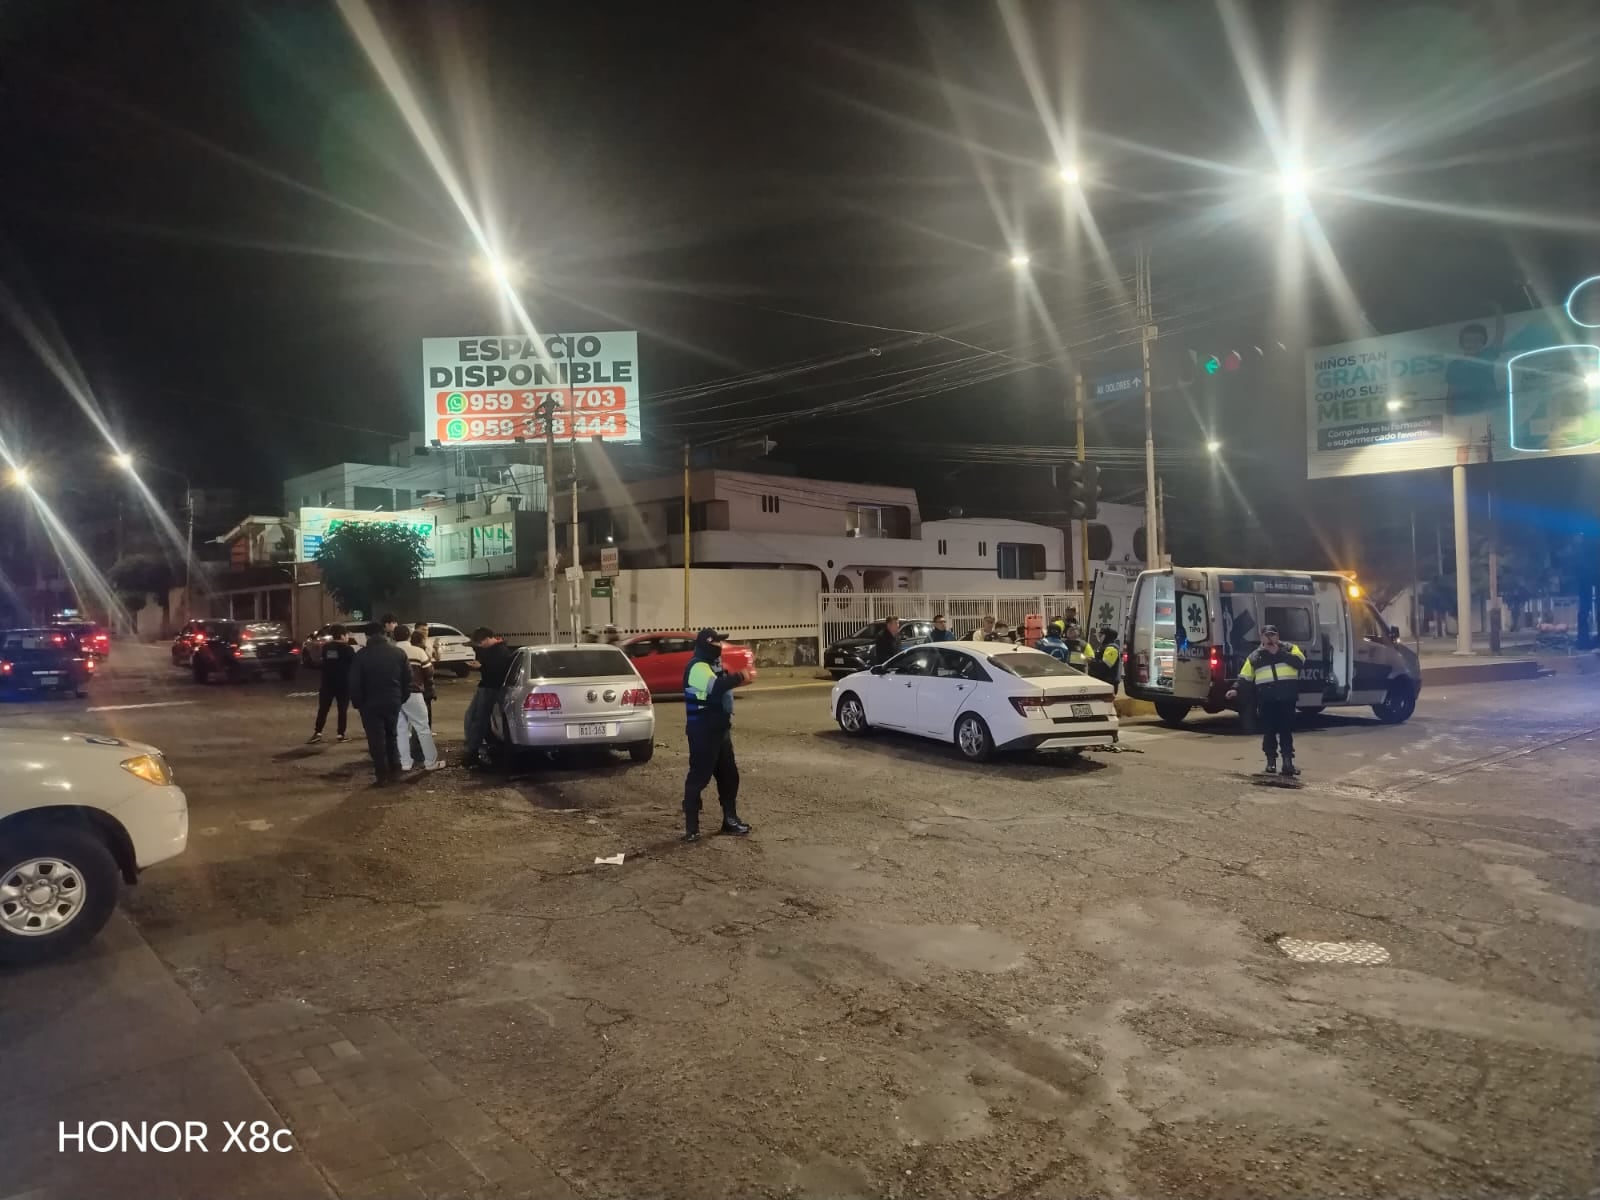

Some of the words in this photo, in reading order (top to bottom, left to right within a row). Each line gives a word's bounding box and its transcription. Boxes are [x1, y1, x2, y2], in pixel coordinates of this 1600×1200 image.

[458, 336, 602, 361] ESPACIO
[1314, 354, 1357, 371] NIÑOS
[1358, 351, 1388, 364] TAN
[1314, 354, 1445, 389] GRANDES
[429, 360, 633, 388] DISPONIBLE
[470, 393, 514, 411] 959
[521, 391, 564, 409] 378
[573, 389, 616, 408] 703
[1314, 388, 1357, 402] COMO
[1359, 384, 1389, 397] SUS
[470, 419, 514, 437] 959
[574, 415, 617, 434] 444
[1333, 432, 1397, 447] supermercado
